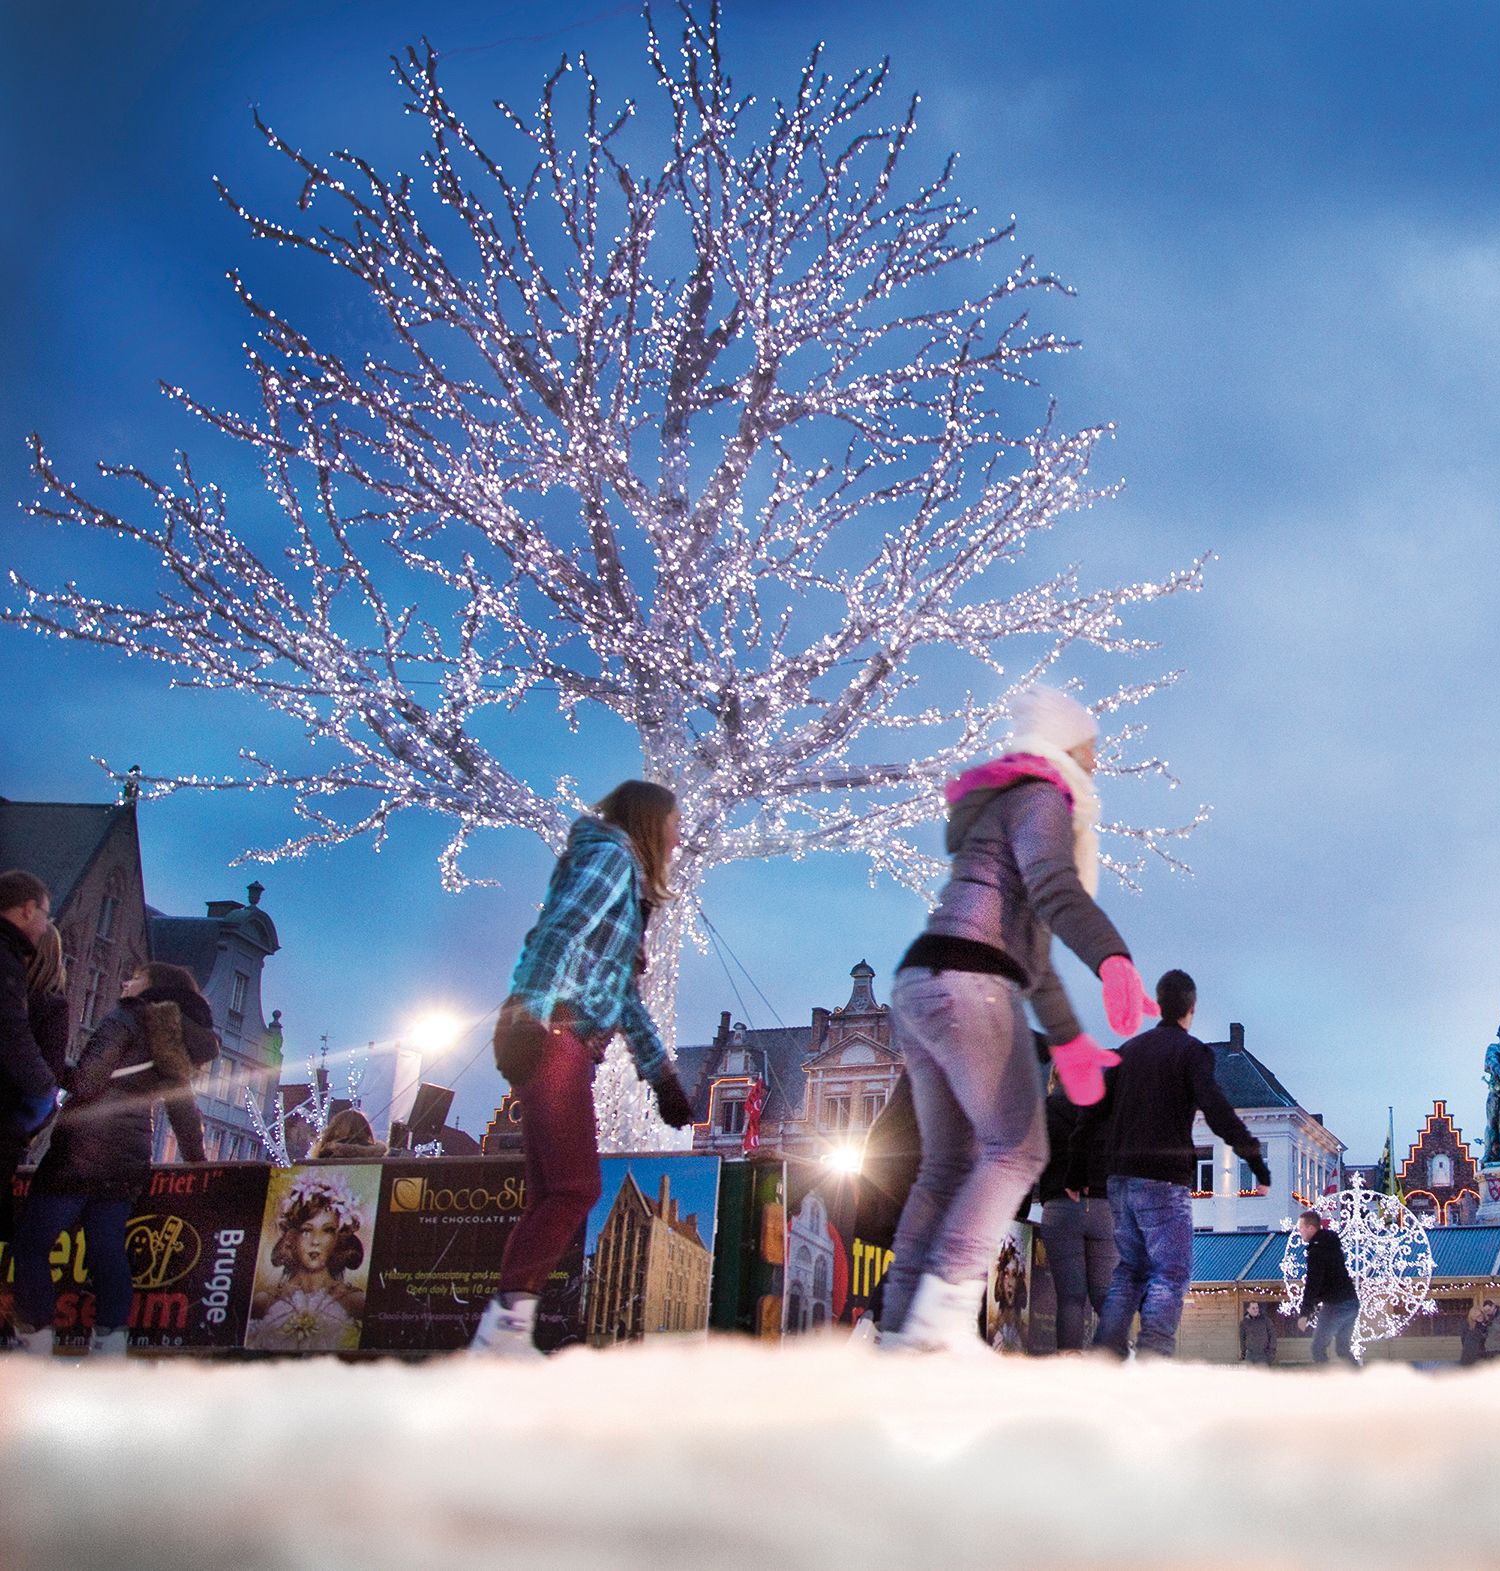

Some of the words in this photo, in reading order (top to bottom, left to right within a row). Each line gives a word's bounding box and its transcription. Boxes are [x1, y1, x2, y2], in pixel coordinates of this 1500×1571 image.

[150, 1171, 196, 1196] friet
[390, 1177, 527, 1213] Choco-St
[442, 1216, 504, 1224] CHOCOLATE
[202, 1229, 245, 1323] Brugge
[406, 1284, 428, 1296] Open
